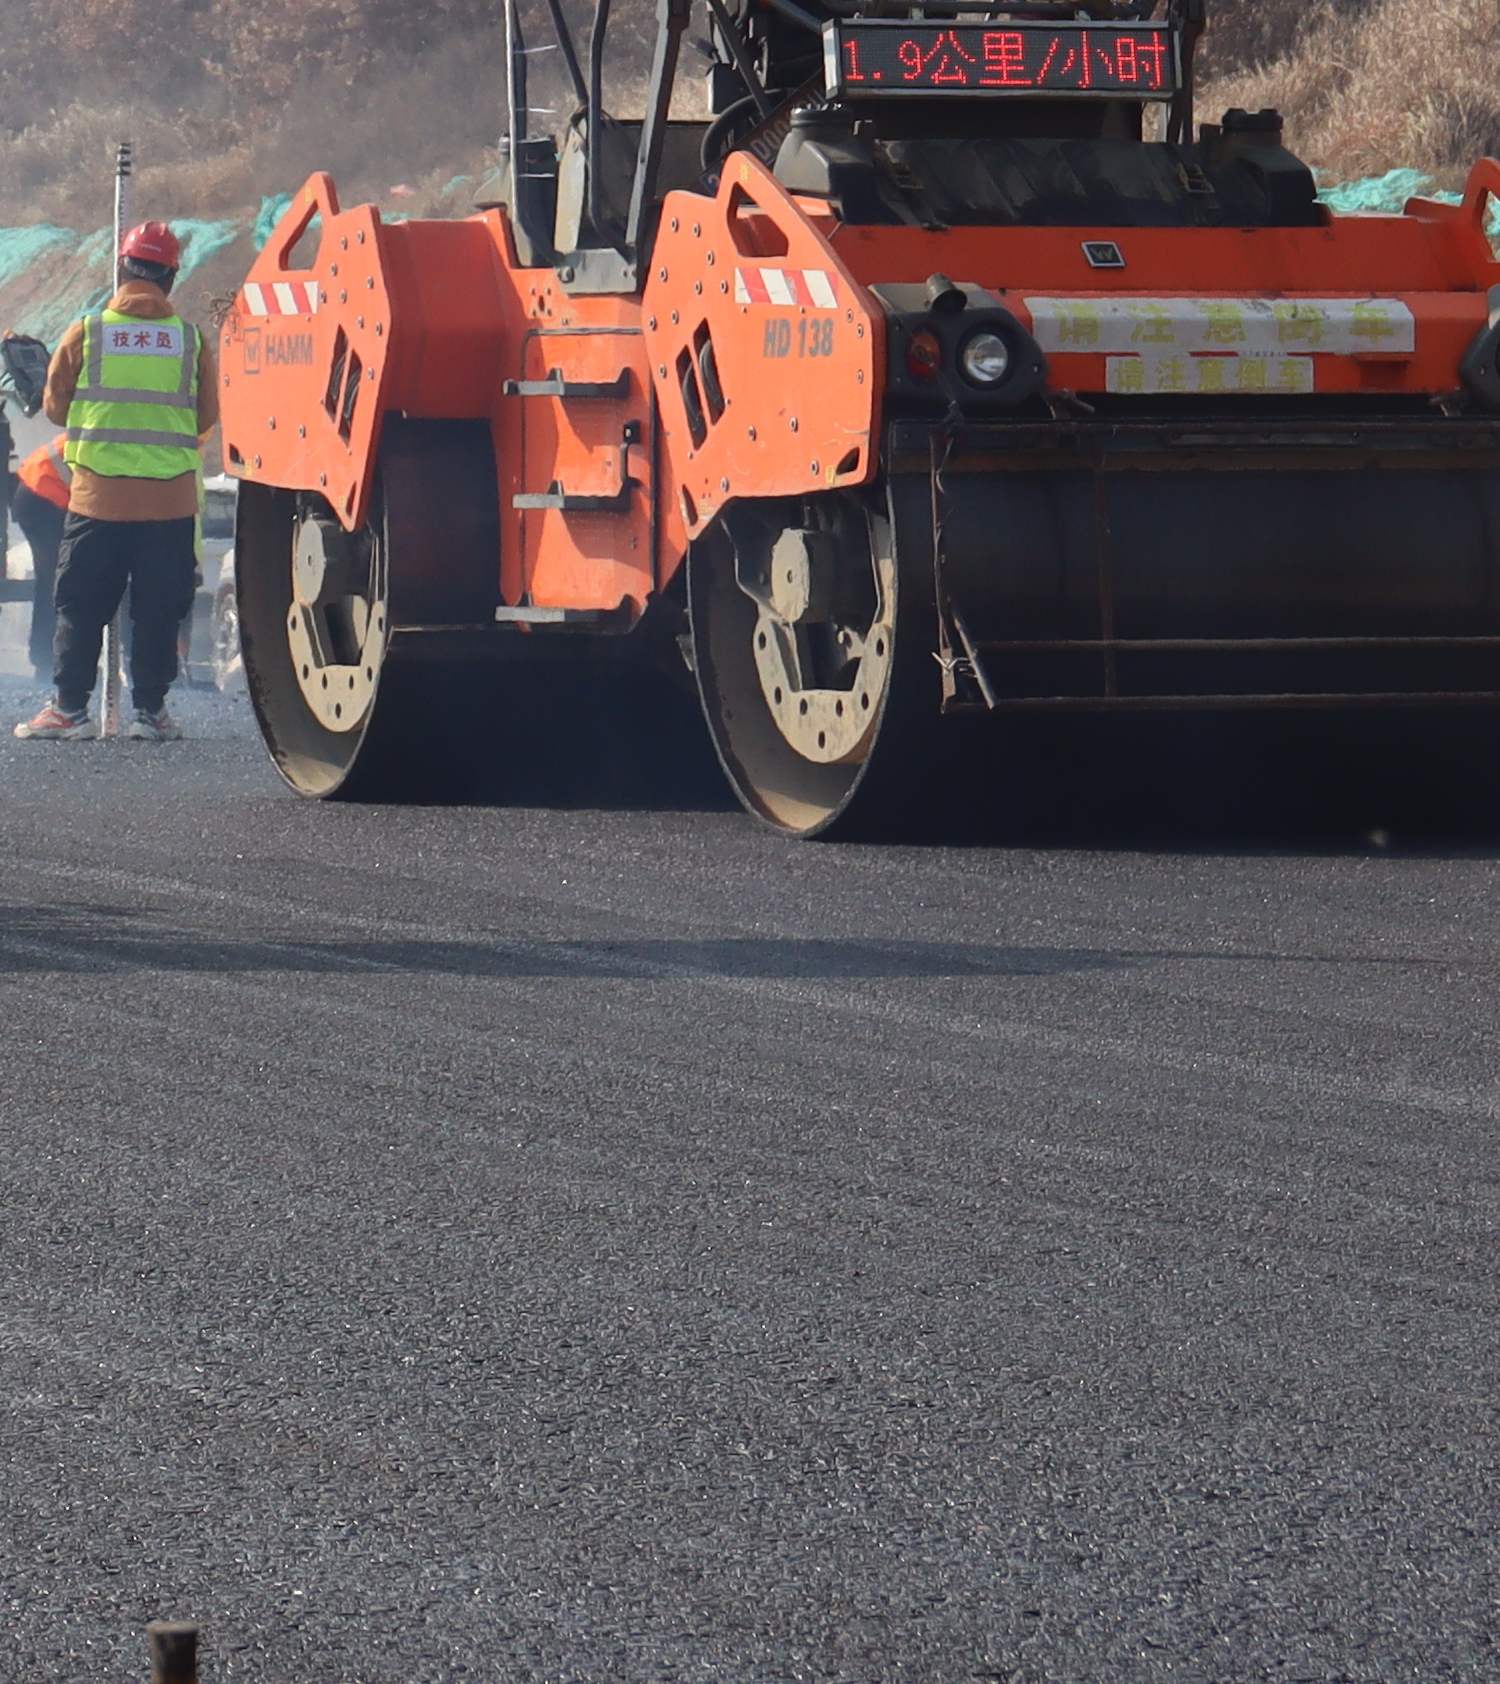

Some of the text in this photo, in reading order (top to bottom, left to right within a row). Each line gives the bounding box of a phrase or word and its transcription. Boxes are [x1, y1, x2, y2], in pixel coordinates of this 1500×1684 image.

[843, 30, 1165, 89] 1.9公里/小时
[112, 330, 172, 349] 技术员
[266, 334, 313, 366] HAMM
[764, 318, 834, 358] HD 138
